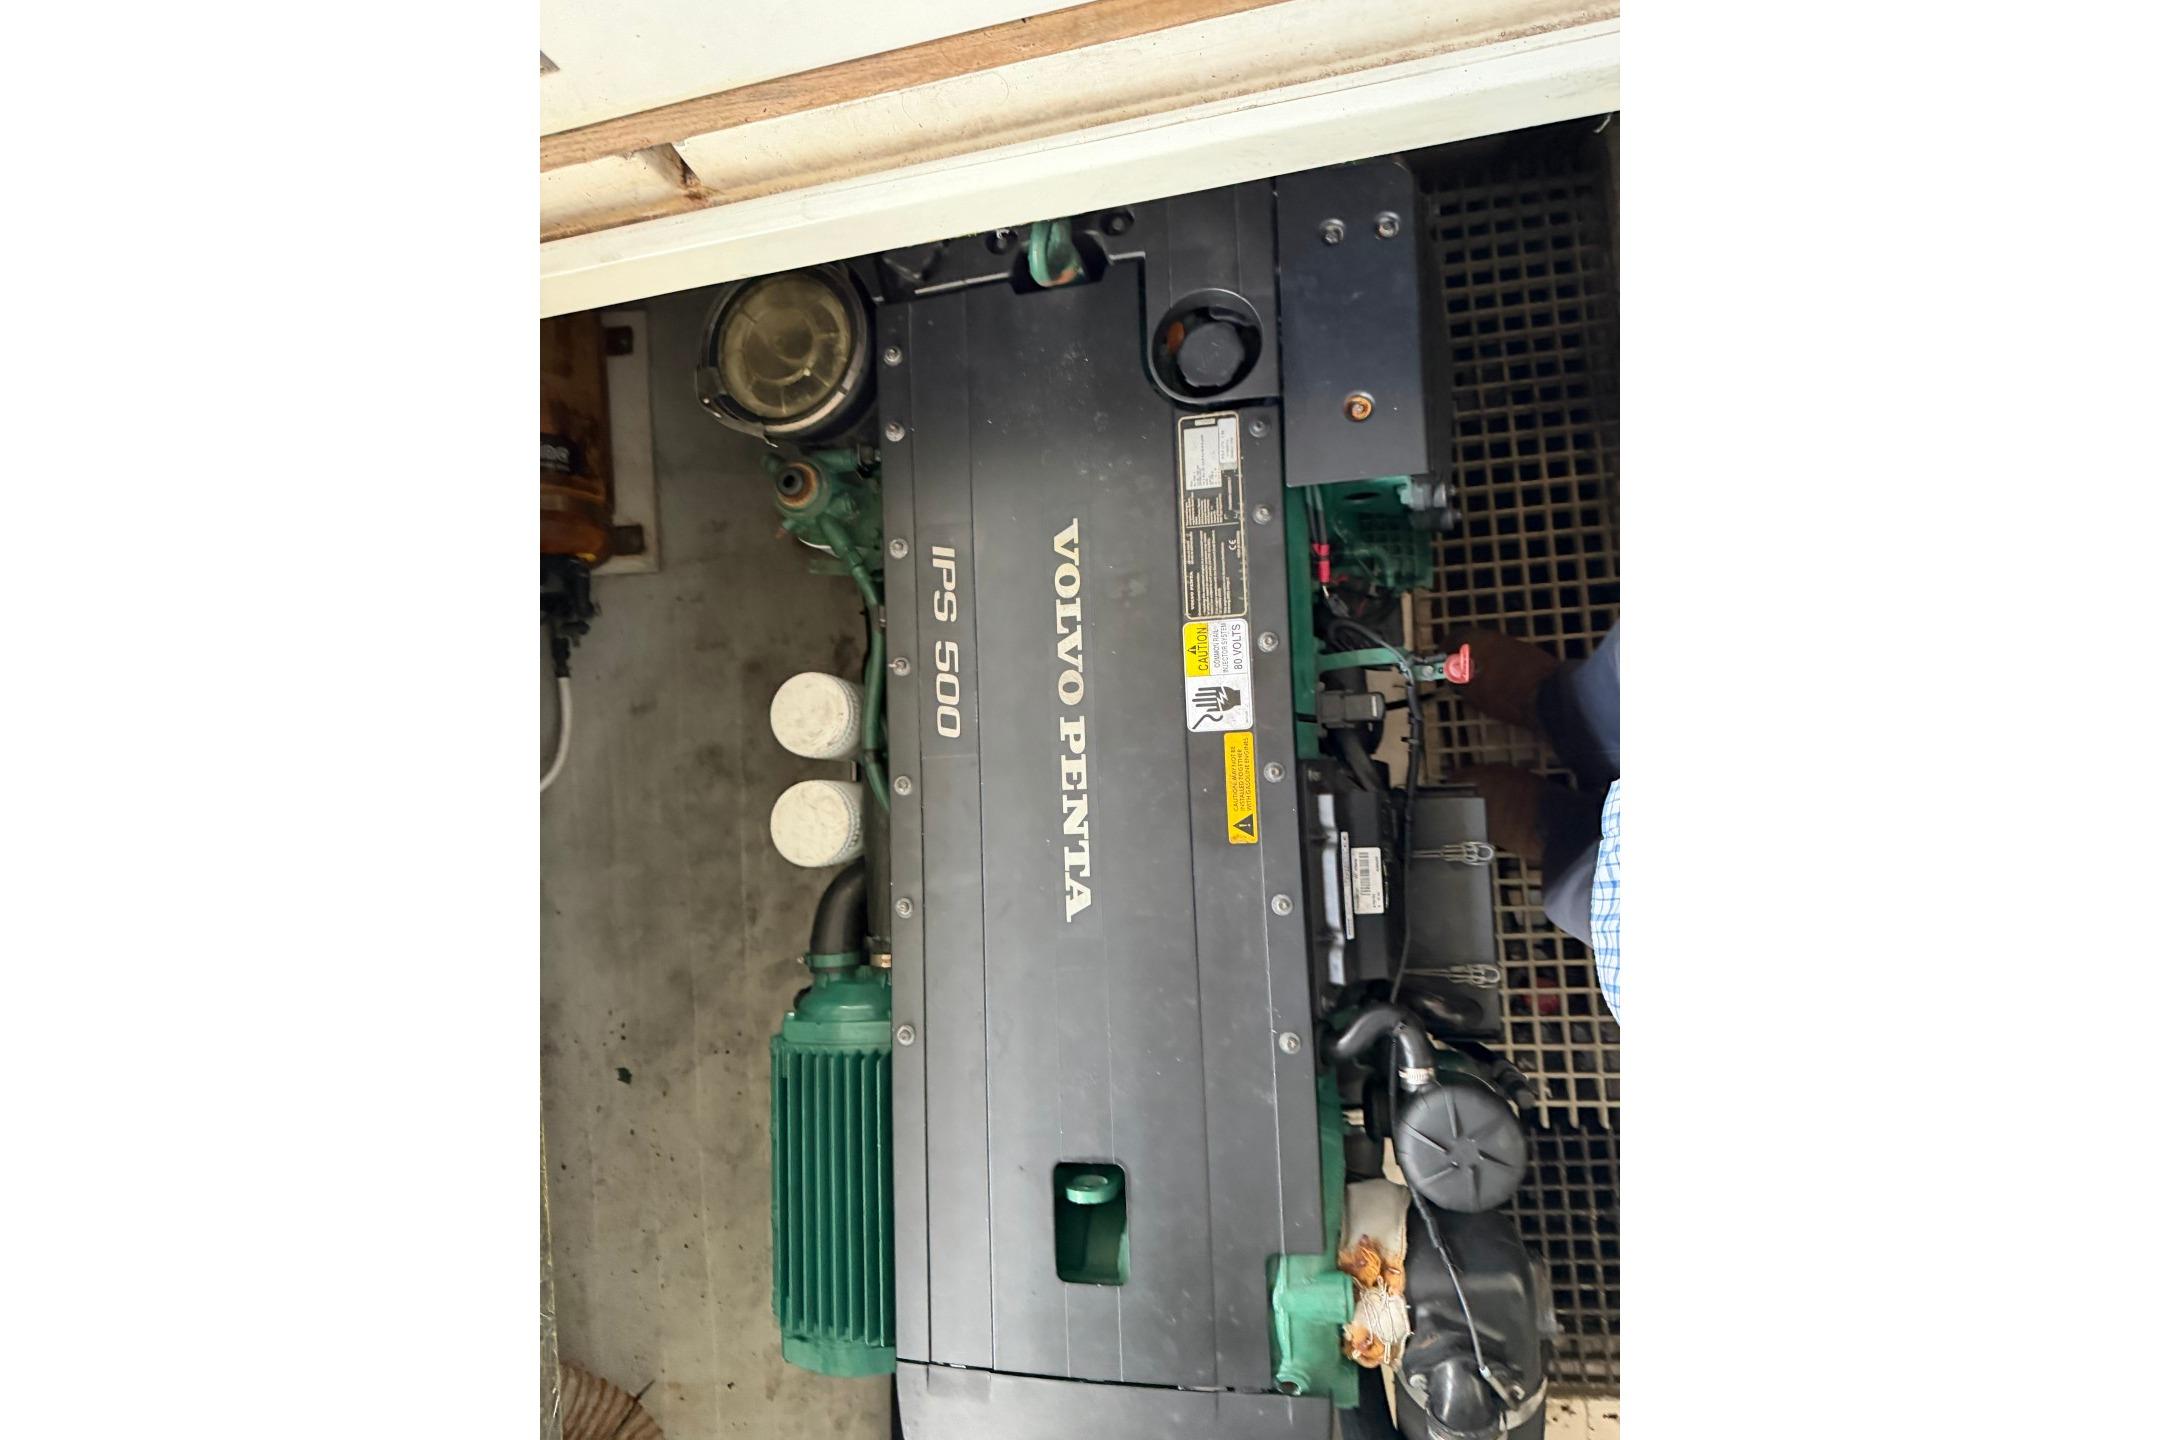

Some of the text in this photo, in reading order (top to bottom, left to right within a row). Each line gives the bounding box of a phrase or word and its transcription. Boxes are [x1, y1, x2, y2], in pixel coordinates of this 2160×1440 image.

[931, 545, 961, 739] IPS 500
[1197, 627, 1209, 671] CAUTION
[1213, 642, 1221, 668] COMMON
[1220, 622, 1229, 673] INJECTOR SYSTEM
[1231, 624, 1243, 670] 80 VOLTS
[1053, 518, 1092, 923] VOLVO PENTA
